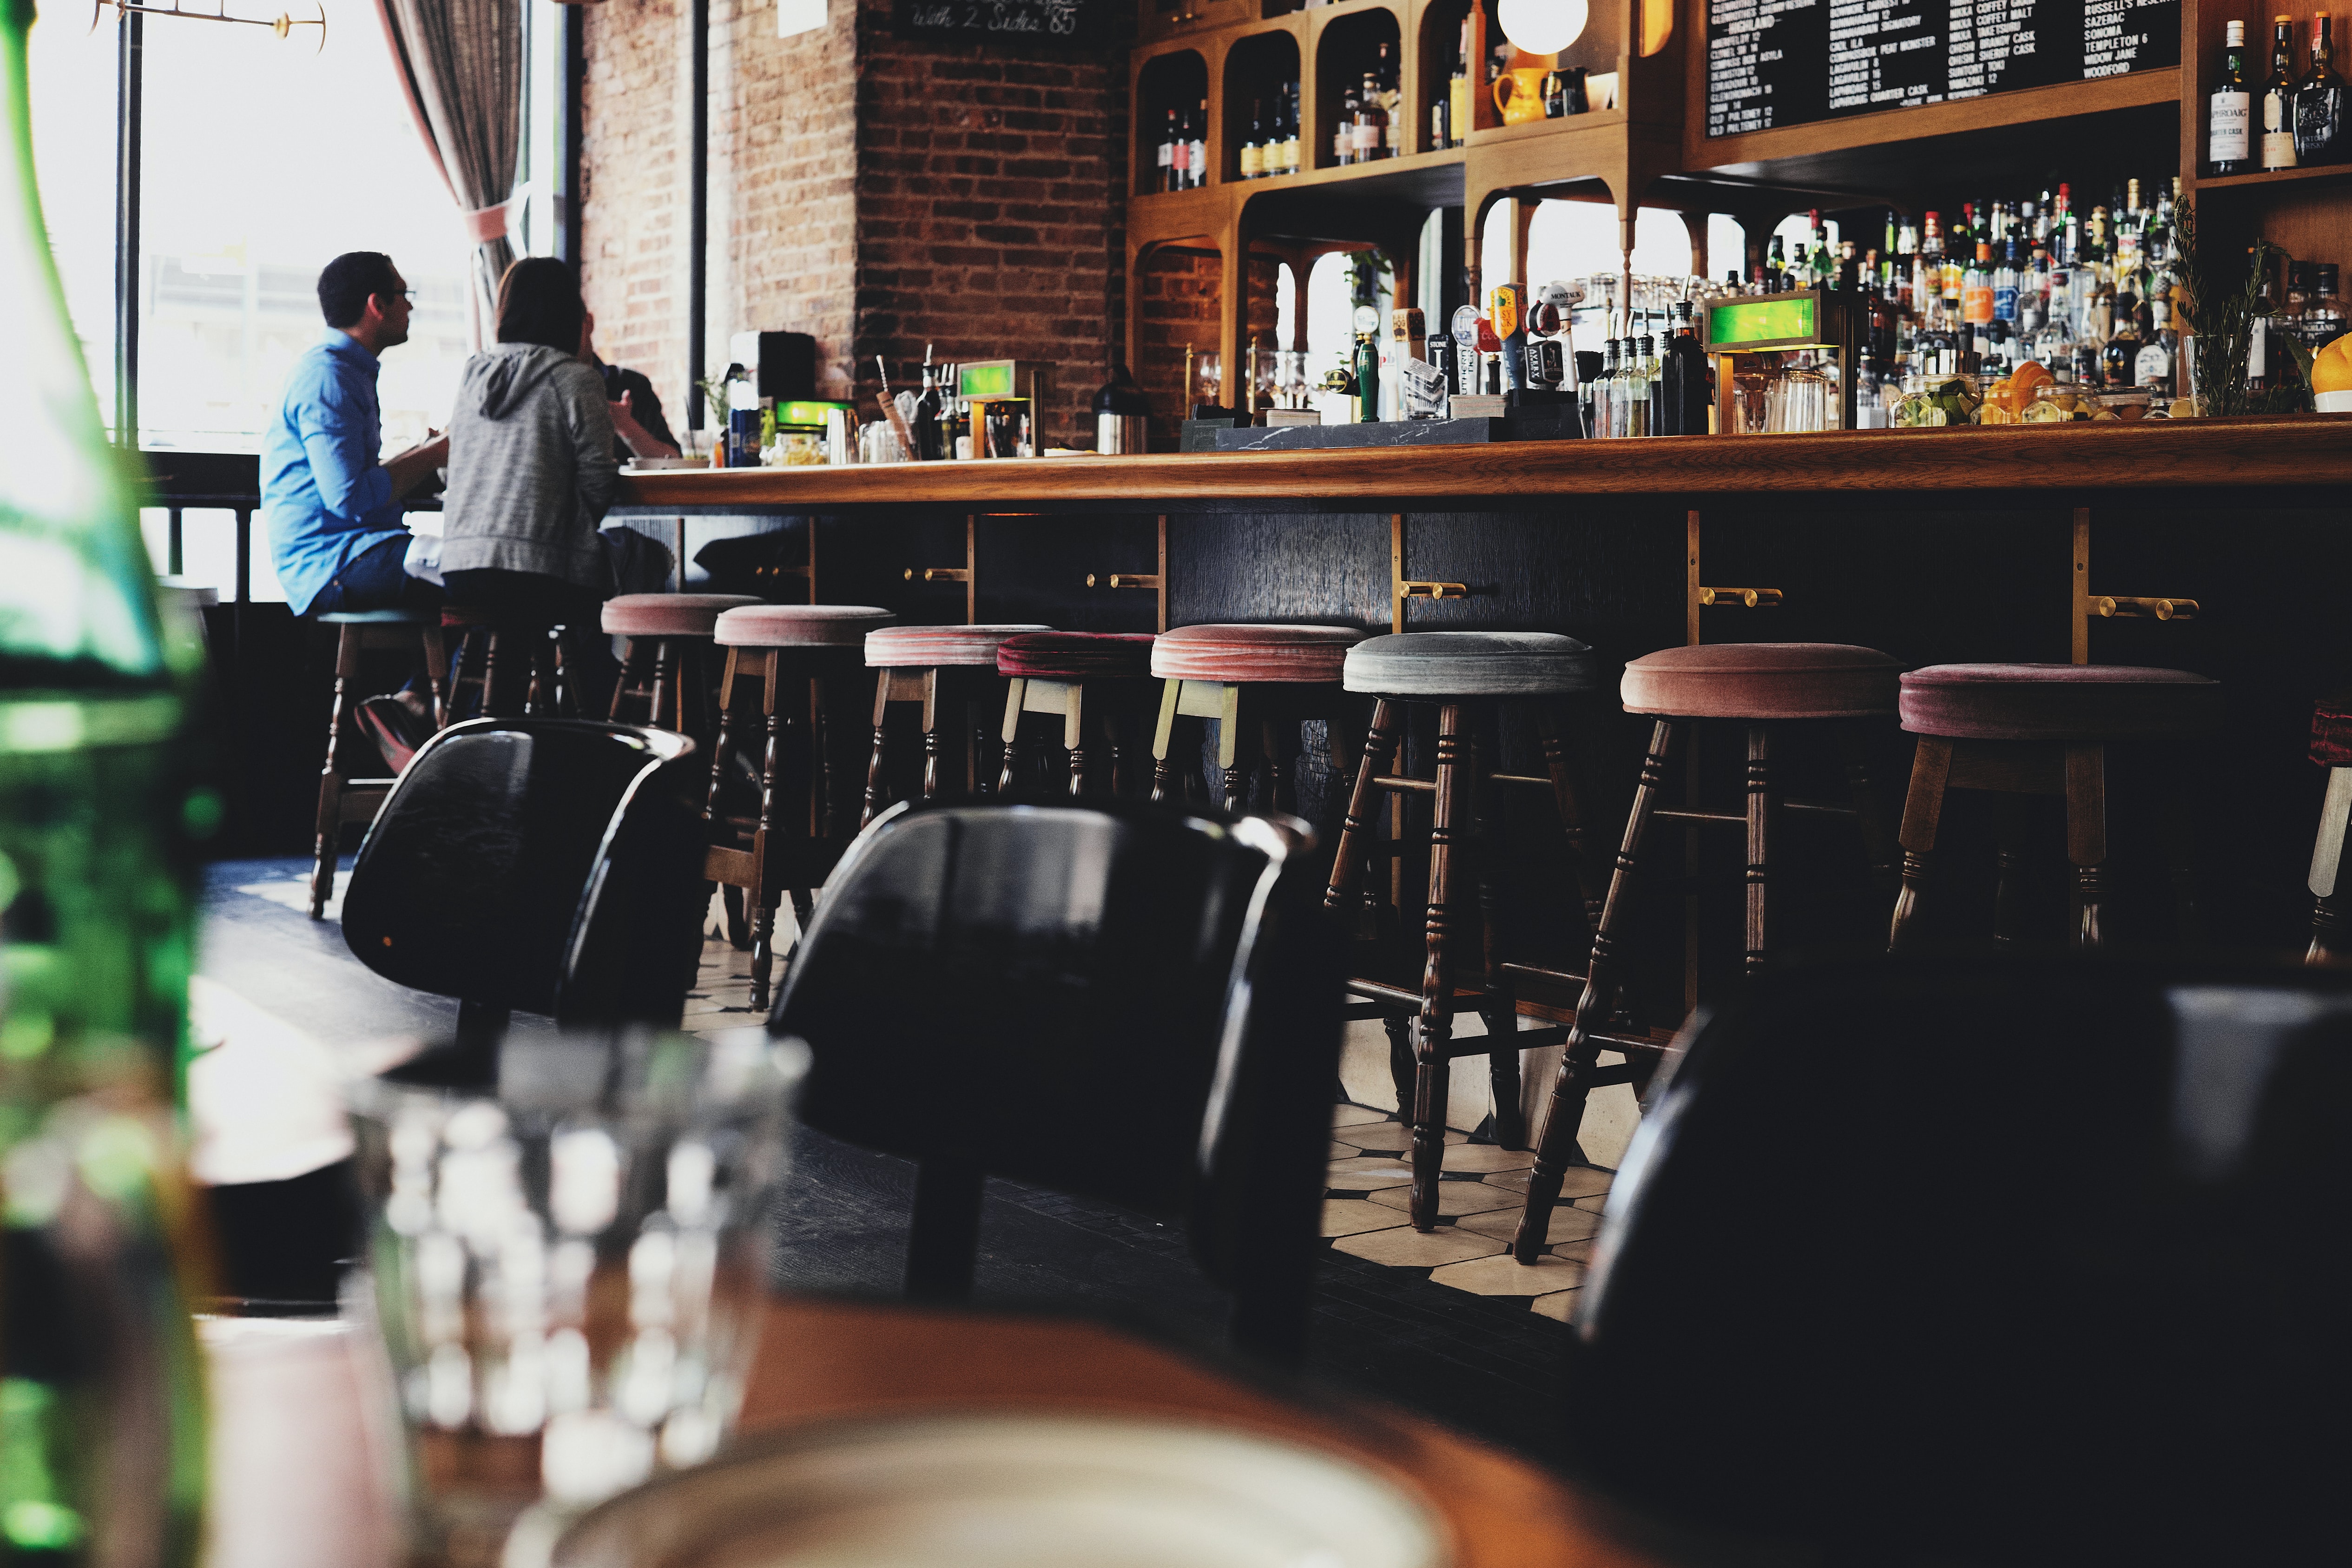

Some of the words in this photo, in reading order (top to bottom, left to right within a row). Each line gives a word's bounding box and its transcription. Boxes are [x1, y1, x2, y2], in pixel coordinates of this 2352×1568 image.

[962, 6, 982, 28] 2
[988, 2, 1044, 32] Sides
[1882, 10, 1890, 20] 12
[1950, 6, 1973, 19] NIKKA
[1976, 0, 2007, 13] COFFEY
[1729, 15, 1775, 35] HIGHLAND
[1950, 18, 1972, 31] NIKKA
[1976, 12, 2007, 26] COFFEY
[2010, 7, 2032, 20] MALT
[2084, 12, 2125, 28] SAZERAC
[1949, 30, 1971, 43] NIKKA
[2013, 31, 2035, 43] CASK
[2084, 25, 2122, 40] SONOMA
[1880, 42, 1897, 54] PEAT
[1900, 36, 1935, 51] MONSTER
[2013, 43, 2035, 55] CASK
[2085, 34, 2138, 53] TEMPLETON
[2142, 33, 2148, 43] 6
[2084, 52, 2113, 65] WIDOW
[2115, 47, 2137, 60] JANE
[1948, 63, 1984, 78] SUNTORY
[1989, 73, 1997, 83] 12
[2083, 62, 2129, 79] WOODFORD
[1870, 88, 1904, 102] QUARTER
[1908, 85, 1928, 96] CASK
[2212, 108, 2247, 119] PHROAIG
[1551, 291, 1581, 300] MONTAUK
[1531, 349, 1540, 377] AVERY
